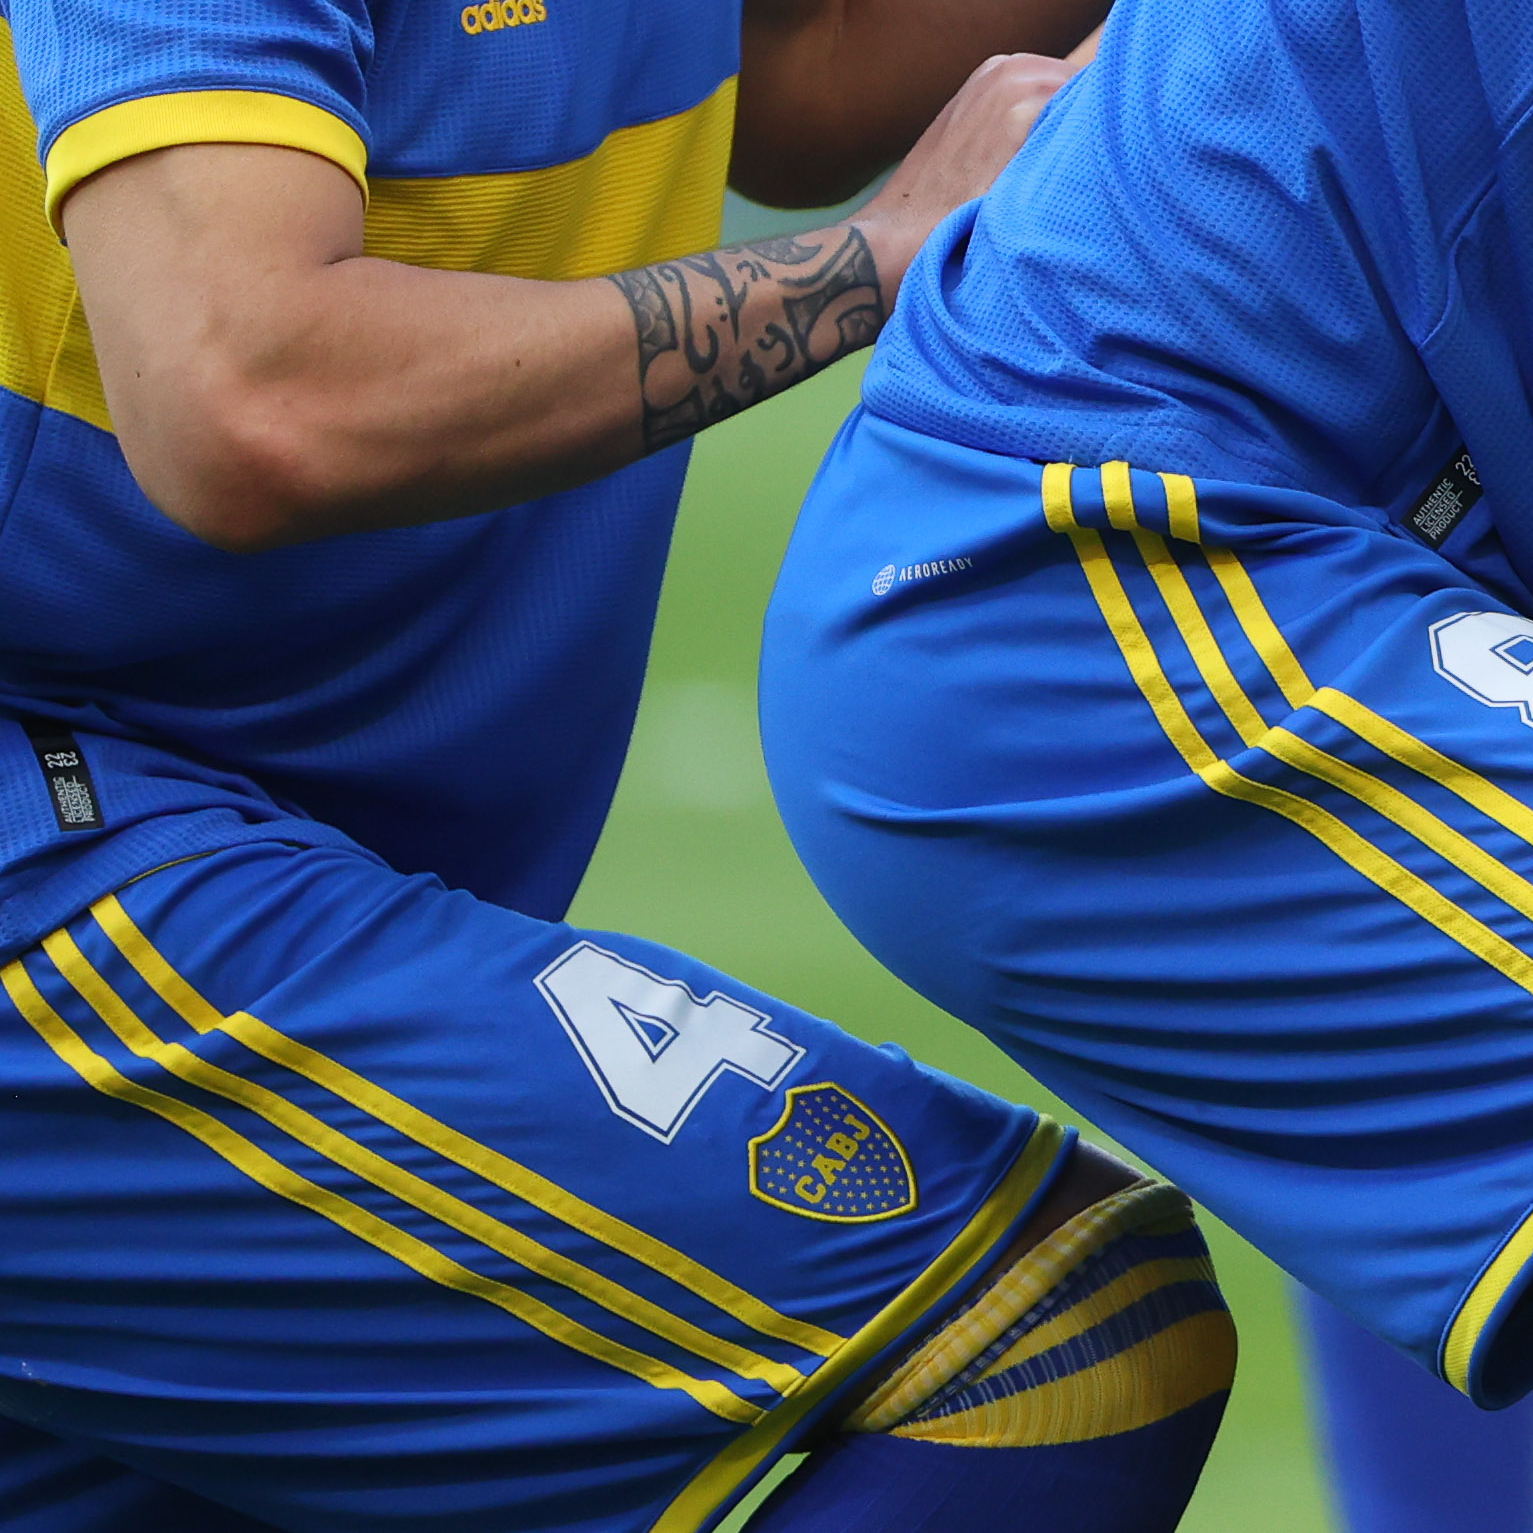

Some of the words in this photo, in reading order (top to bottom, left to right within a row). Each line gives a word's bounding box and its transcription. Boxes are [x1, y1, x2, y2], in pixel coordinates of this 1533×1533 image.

[1412, 477, 1451, 526] AUTHENTIC
[1420, 491, 1456, 533] LICENSED
[1429, 499, 1463, 541] PRODUCT
[898, 556, 973, 582] AEROREADY
[52, 776, 74, 823] AUTHENTIC
[66, 781, 85, 823] LICENSED
[78, 782, 96, 822] PRODUCT
[532, 939, 808, 1146] 4
[794, 1113, 872, 1204] CABJ
